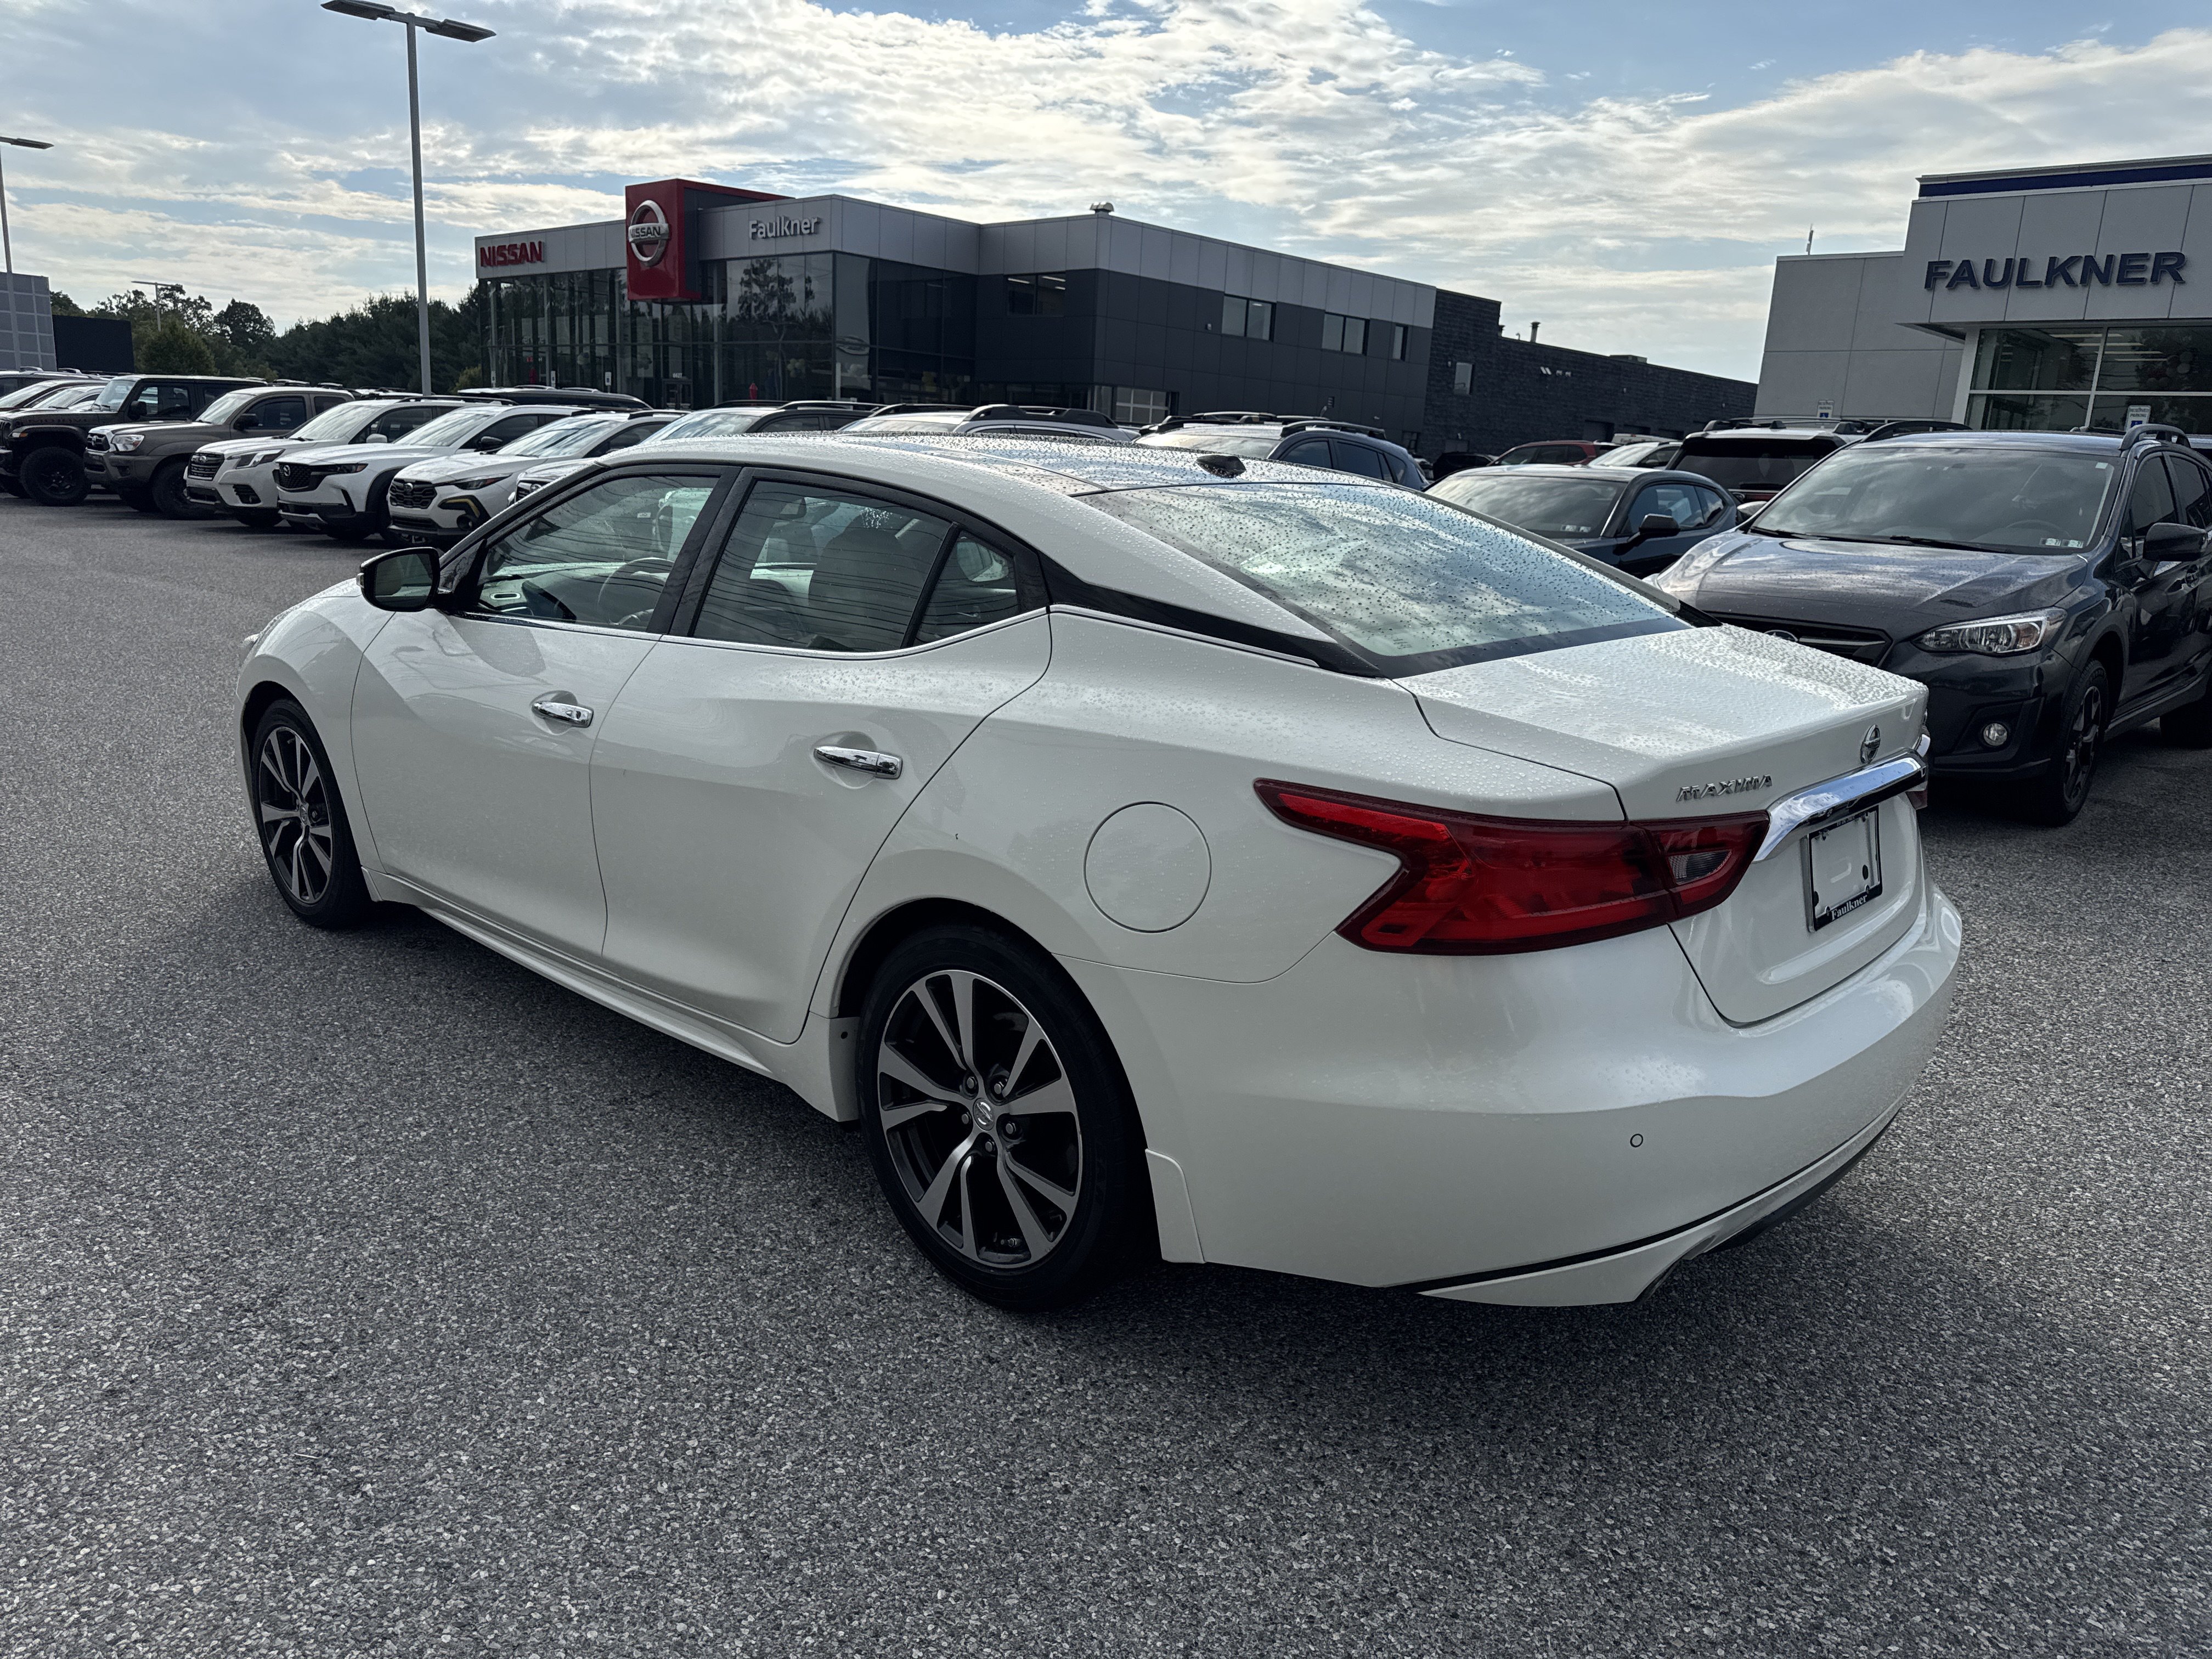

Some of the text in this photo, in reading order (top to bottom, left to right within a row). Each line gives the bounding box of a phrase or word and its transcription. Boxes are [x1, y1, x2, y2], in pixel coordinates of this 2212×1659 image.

[629, 226, 661, 238] NISSAN
[749, 216, 818, 239] Faulkner
[480, 240, 543, 267] NISSAN
[1924, 251, 2187, 289] FAULKNER
[1675, 774, 1773, 803] MAXIMA
[1831, 894, 1868, 921] Faulkner
